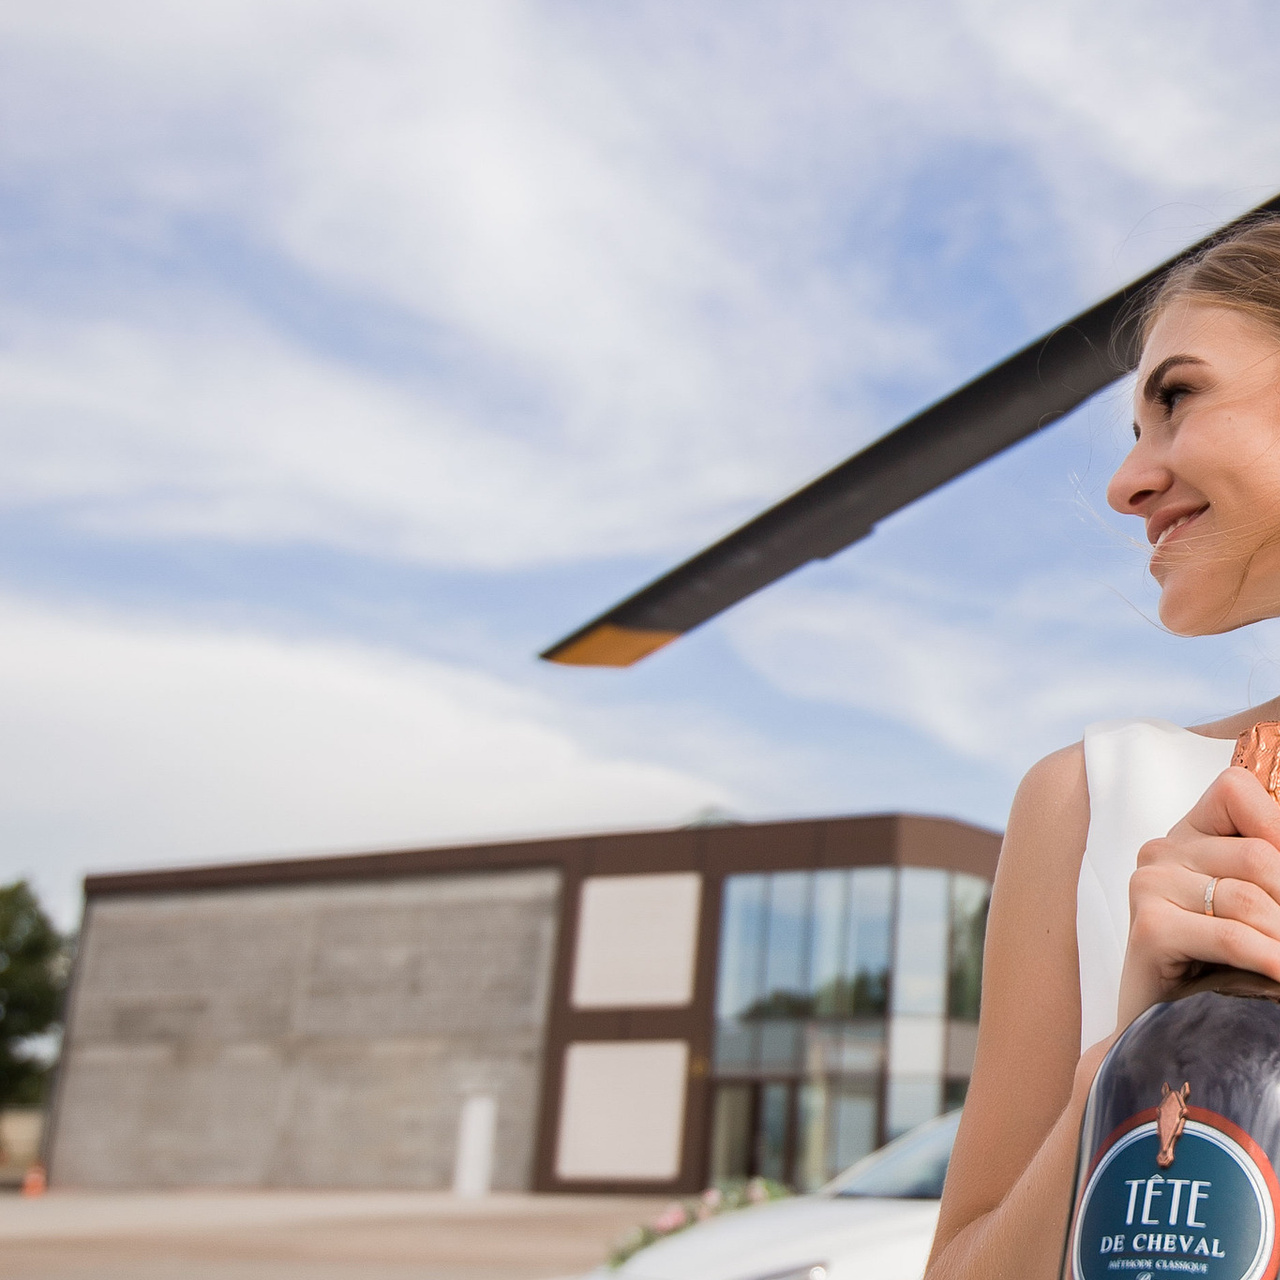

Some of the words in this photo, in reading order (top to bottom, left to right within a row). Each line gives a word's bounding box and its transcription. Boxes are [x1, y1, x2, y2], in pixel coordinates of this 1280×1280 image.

[1125, 1173, 1212, 1229] TÊTE
[1100, 1234, 1126, 1254] DE
[1132, 1233, 1226, 1258] CHEVAL
[1155, 1259, 1209, 1274] CLASSIQUE
